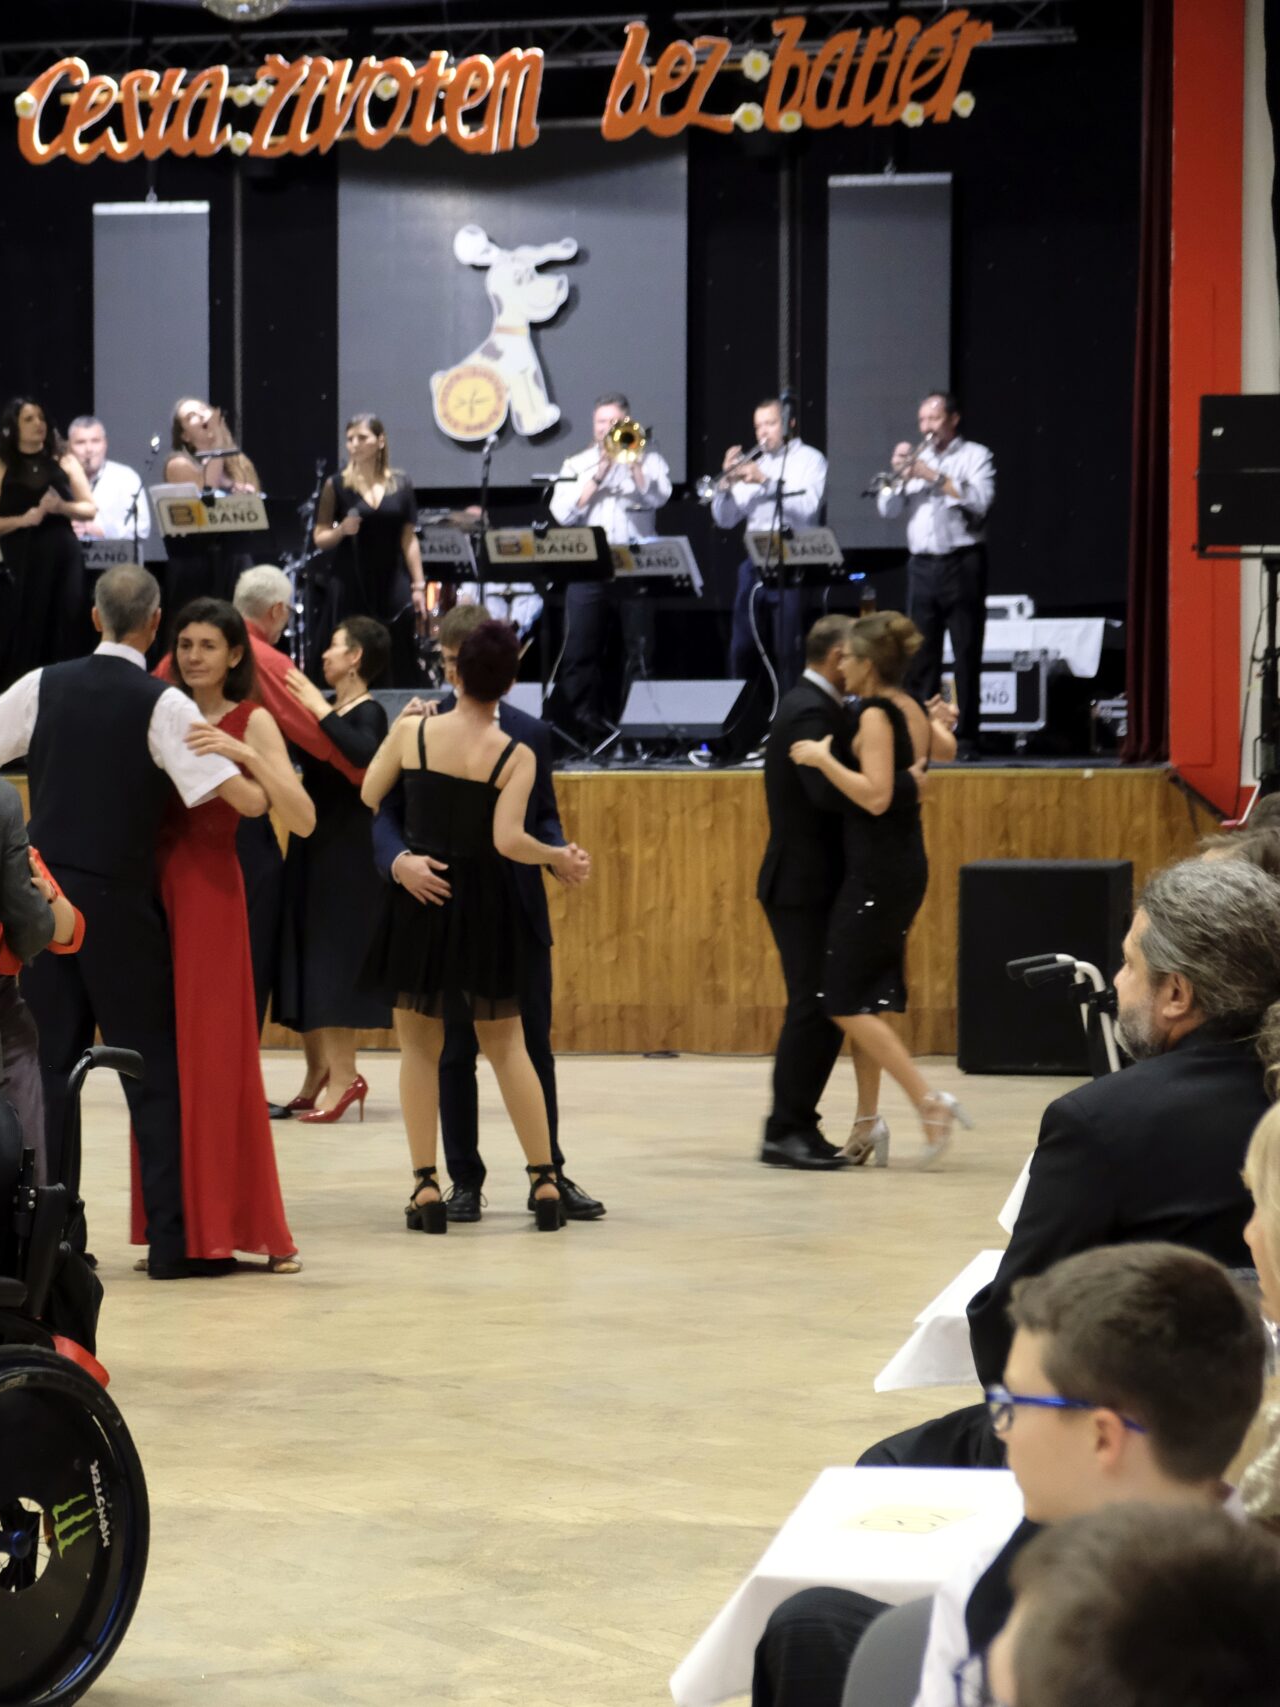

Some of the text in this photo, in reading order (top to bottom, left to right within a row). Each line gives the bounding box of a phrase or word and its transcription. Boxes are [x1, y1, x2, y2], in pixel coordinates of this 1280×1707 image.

[18, 57, 233, 165] Cesta
[602, 21, 734, 141] bez
[764, 9, 993, 132] bariér
[208, 510, 259, 525] BAND
[535, 543, 588, 555] BAND
